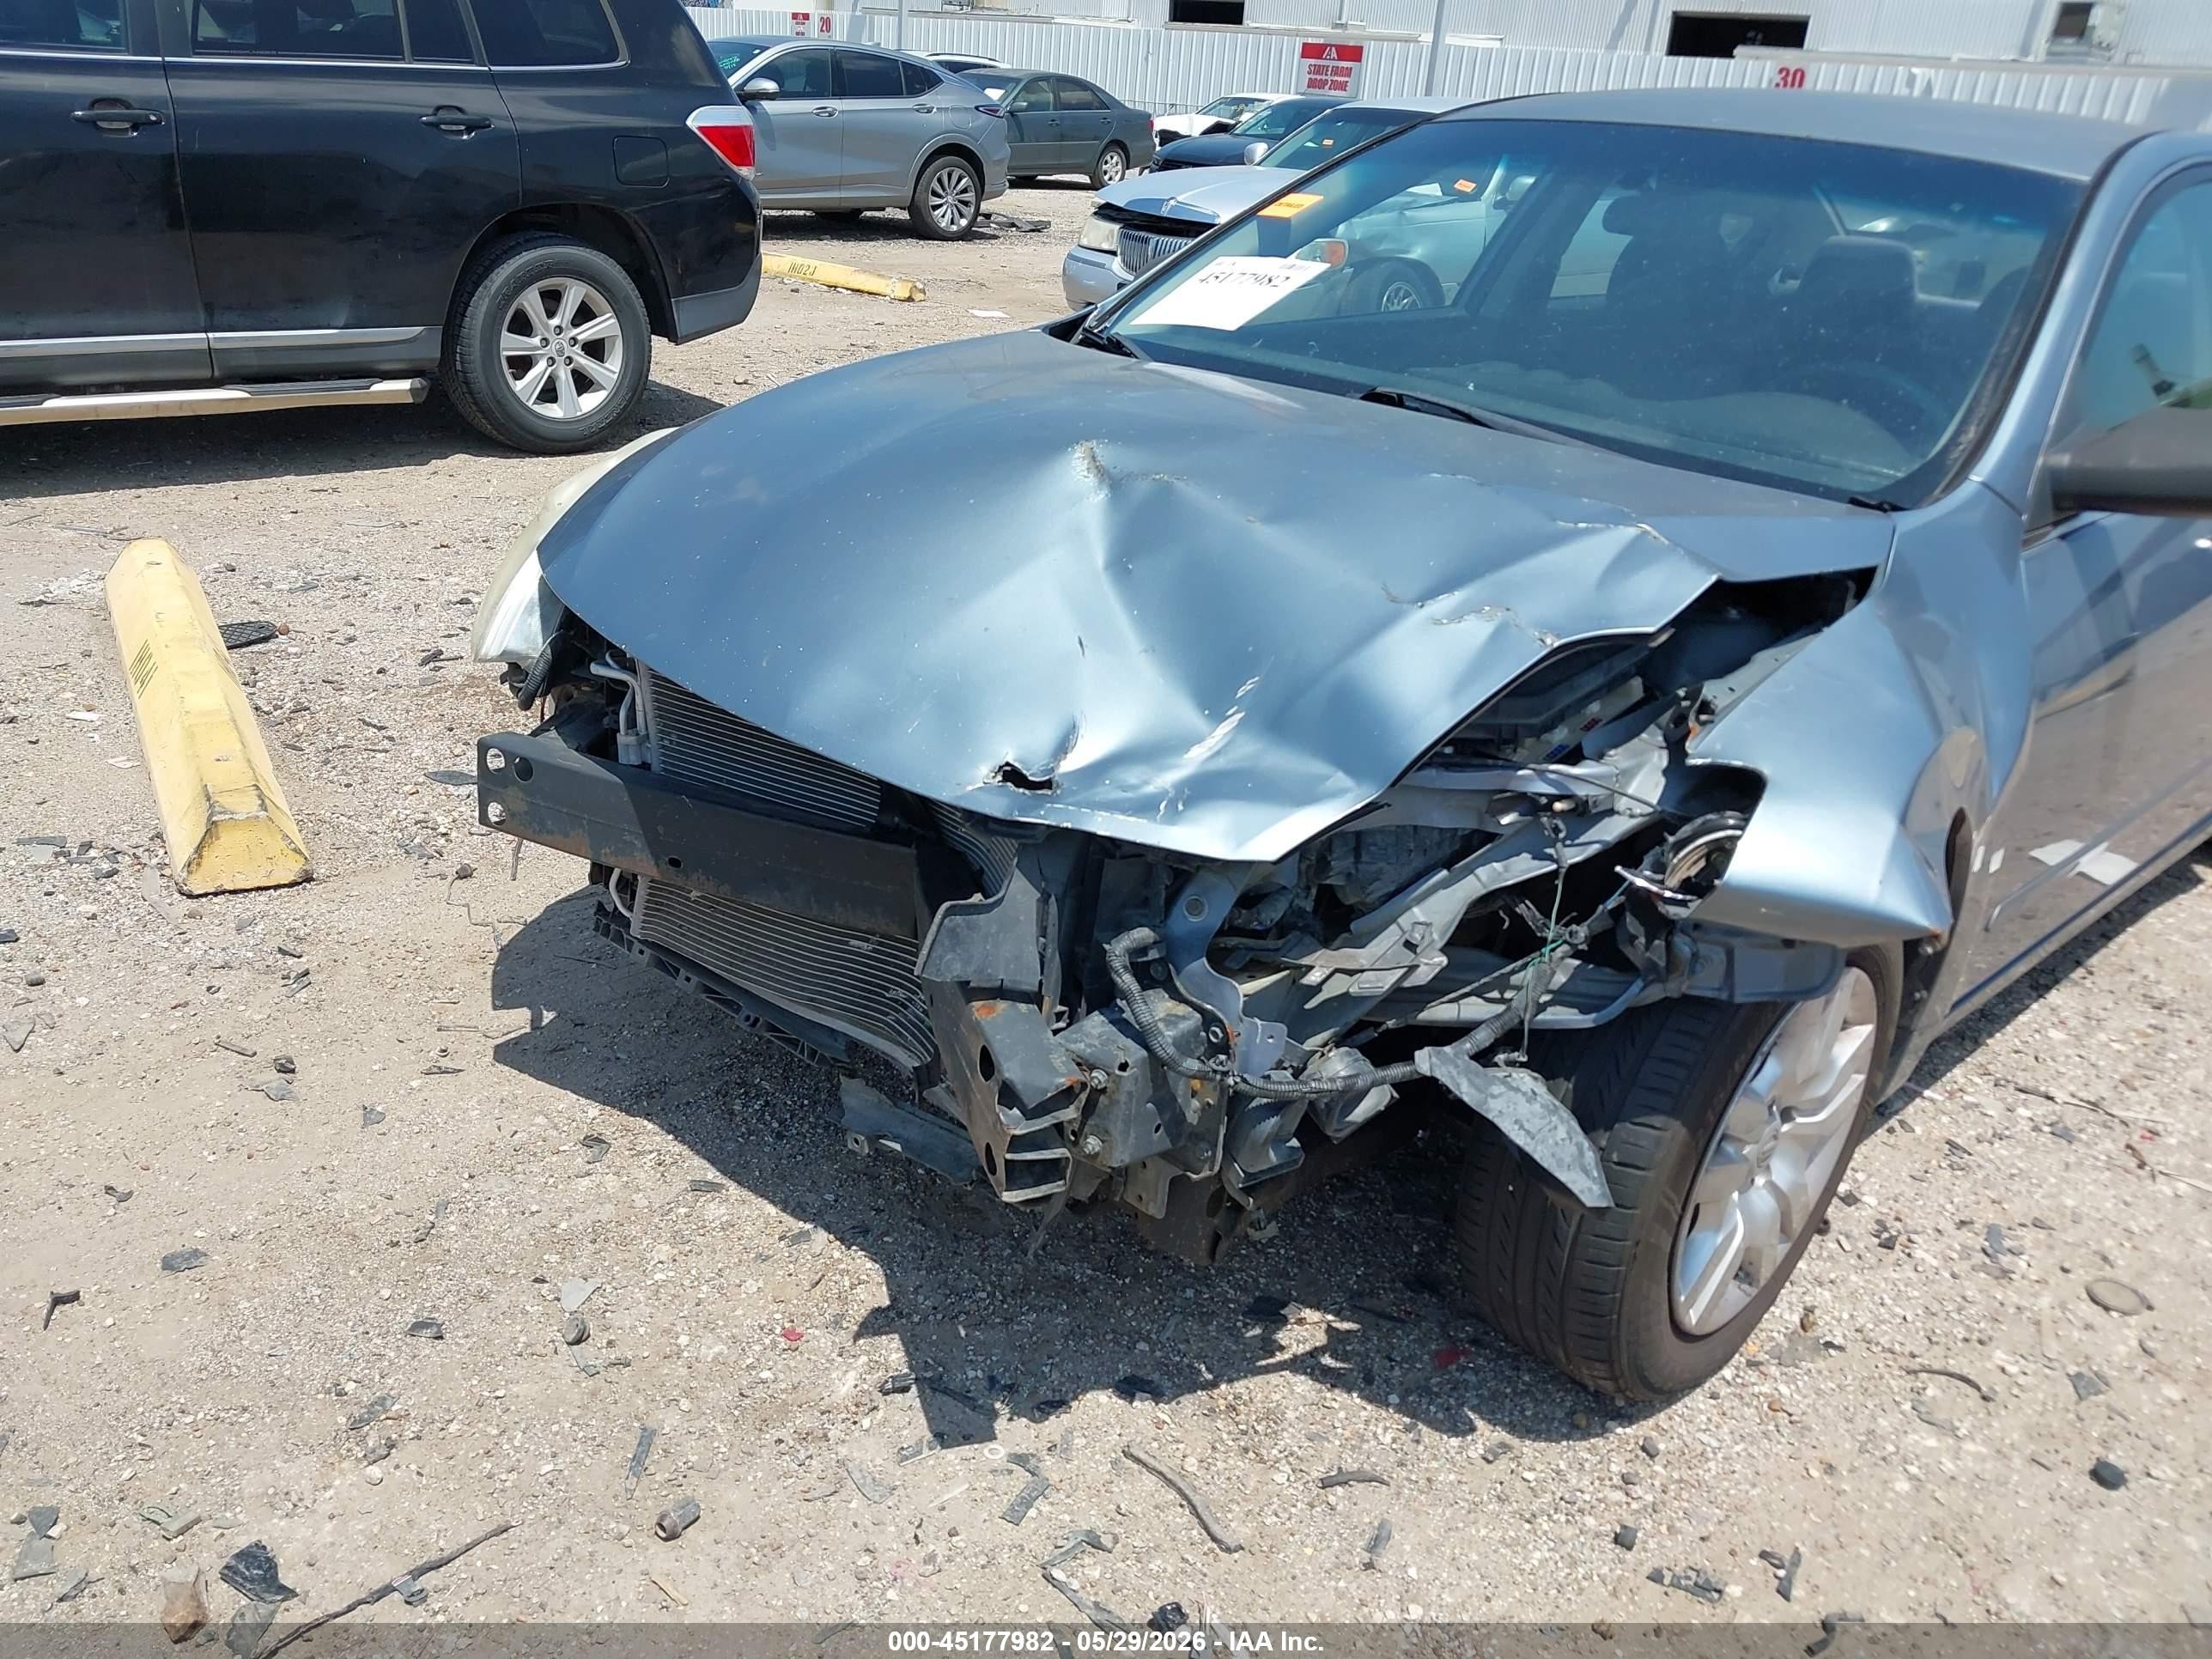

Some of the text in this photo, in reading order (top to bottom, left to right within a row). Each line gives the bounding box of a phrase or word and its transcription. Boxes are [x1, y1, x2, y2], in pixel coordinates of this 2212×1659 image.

[819, 16, 831, 33] 20
[1306, 64, 1353, 78] STATE FARM
[1774, 67, 1806, 88] 30
[1306, 77, 1349, 92] DROP ZONE
[1199, 271, 1291, 288] 45177982
